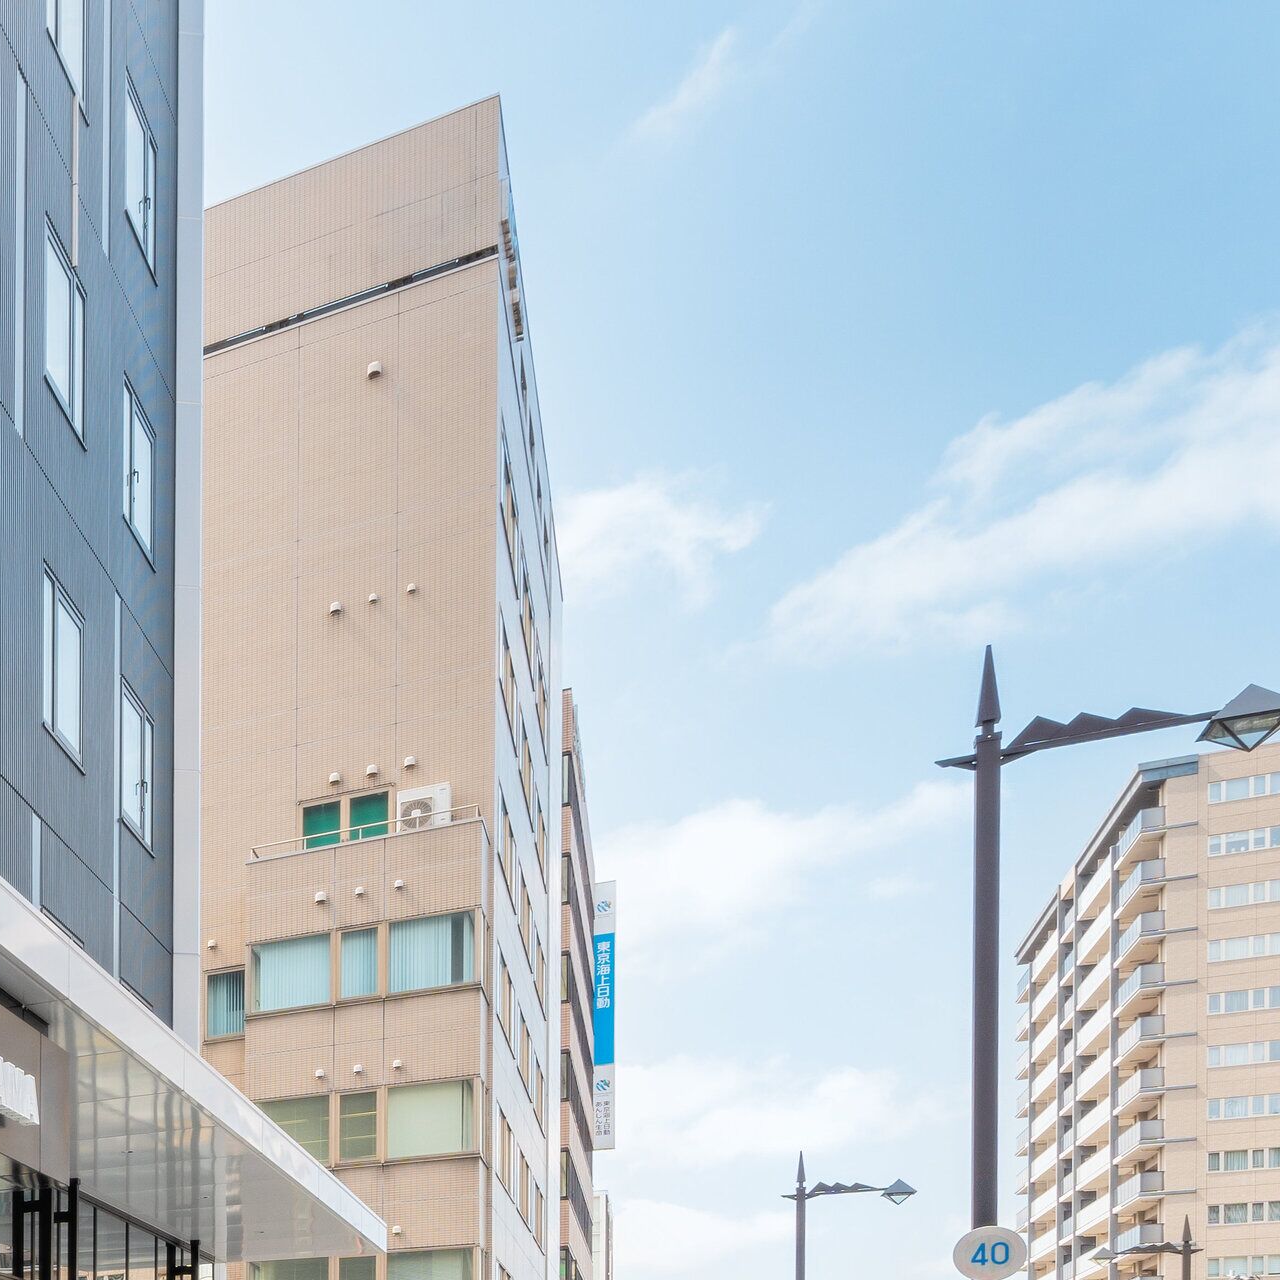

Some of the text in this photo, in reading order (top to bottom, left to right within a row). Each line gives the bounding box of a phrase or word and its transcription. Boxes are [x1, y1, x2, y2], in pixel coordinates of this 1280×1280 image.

[596, 941, 611, 1010] 東京海上日動
[970, 1241, 1010, 1266] 40
